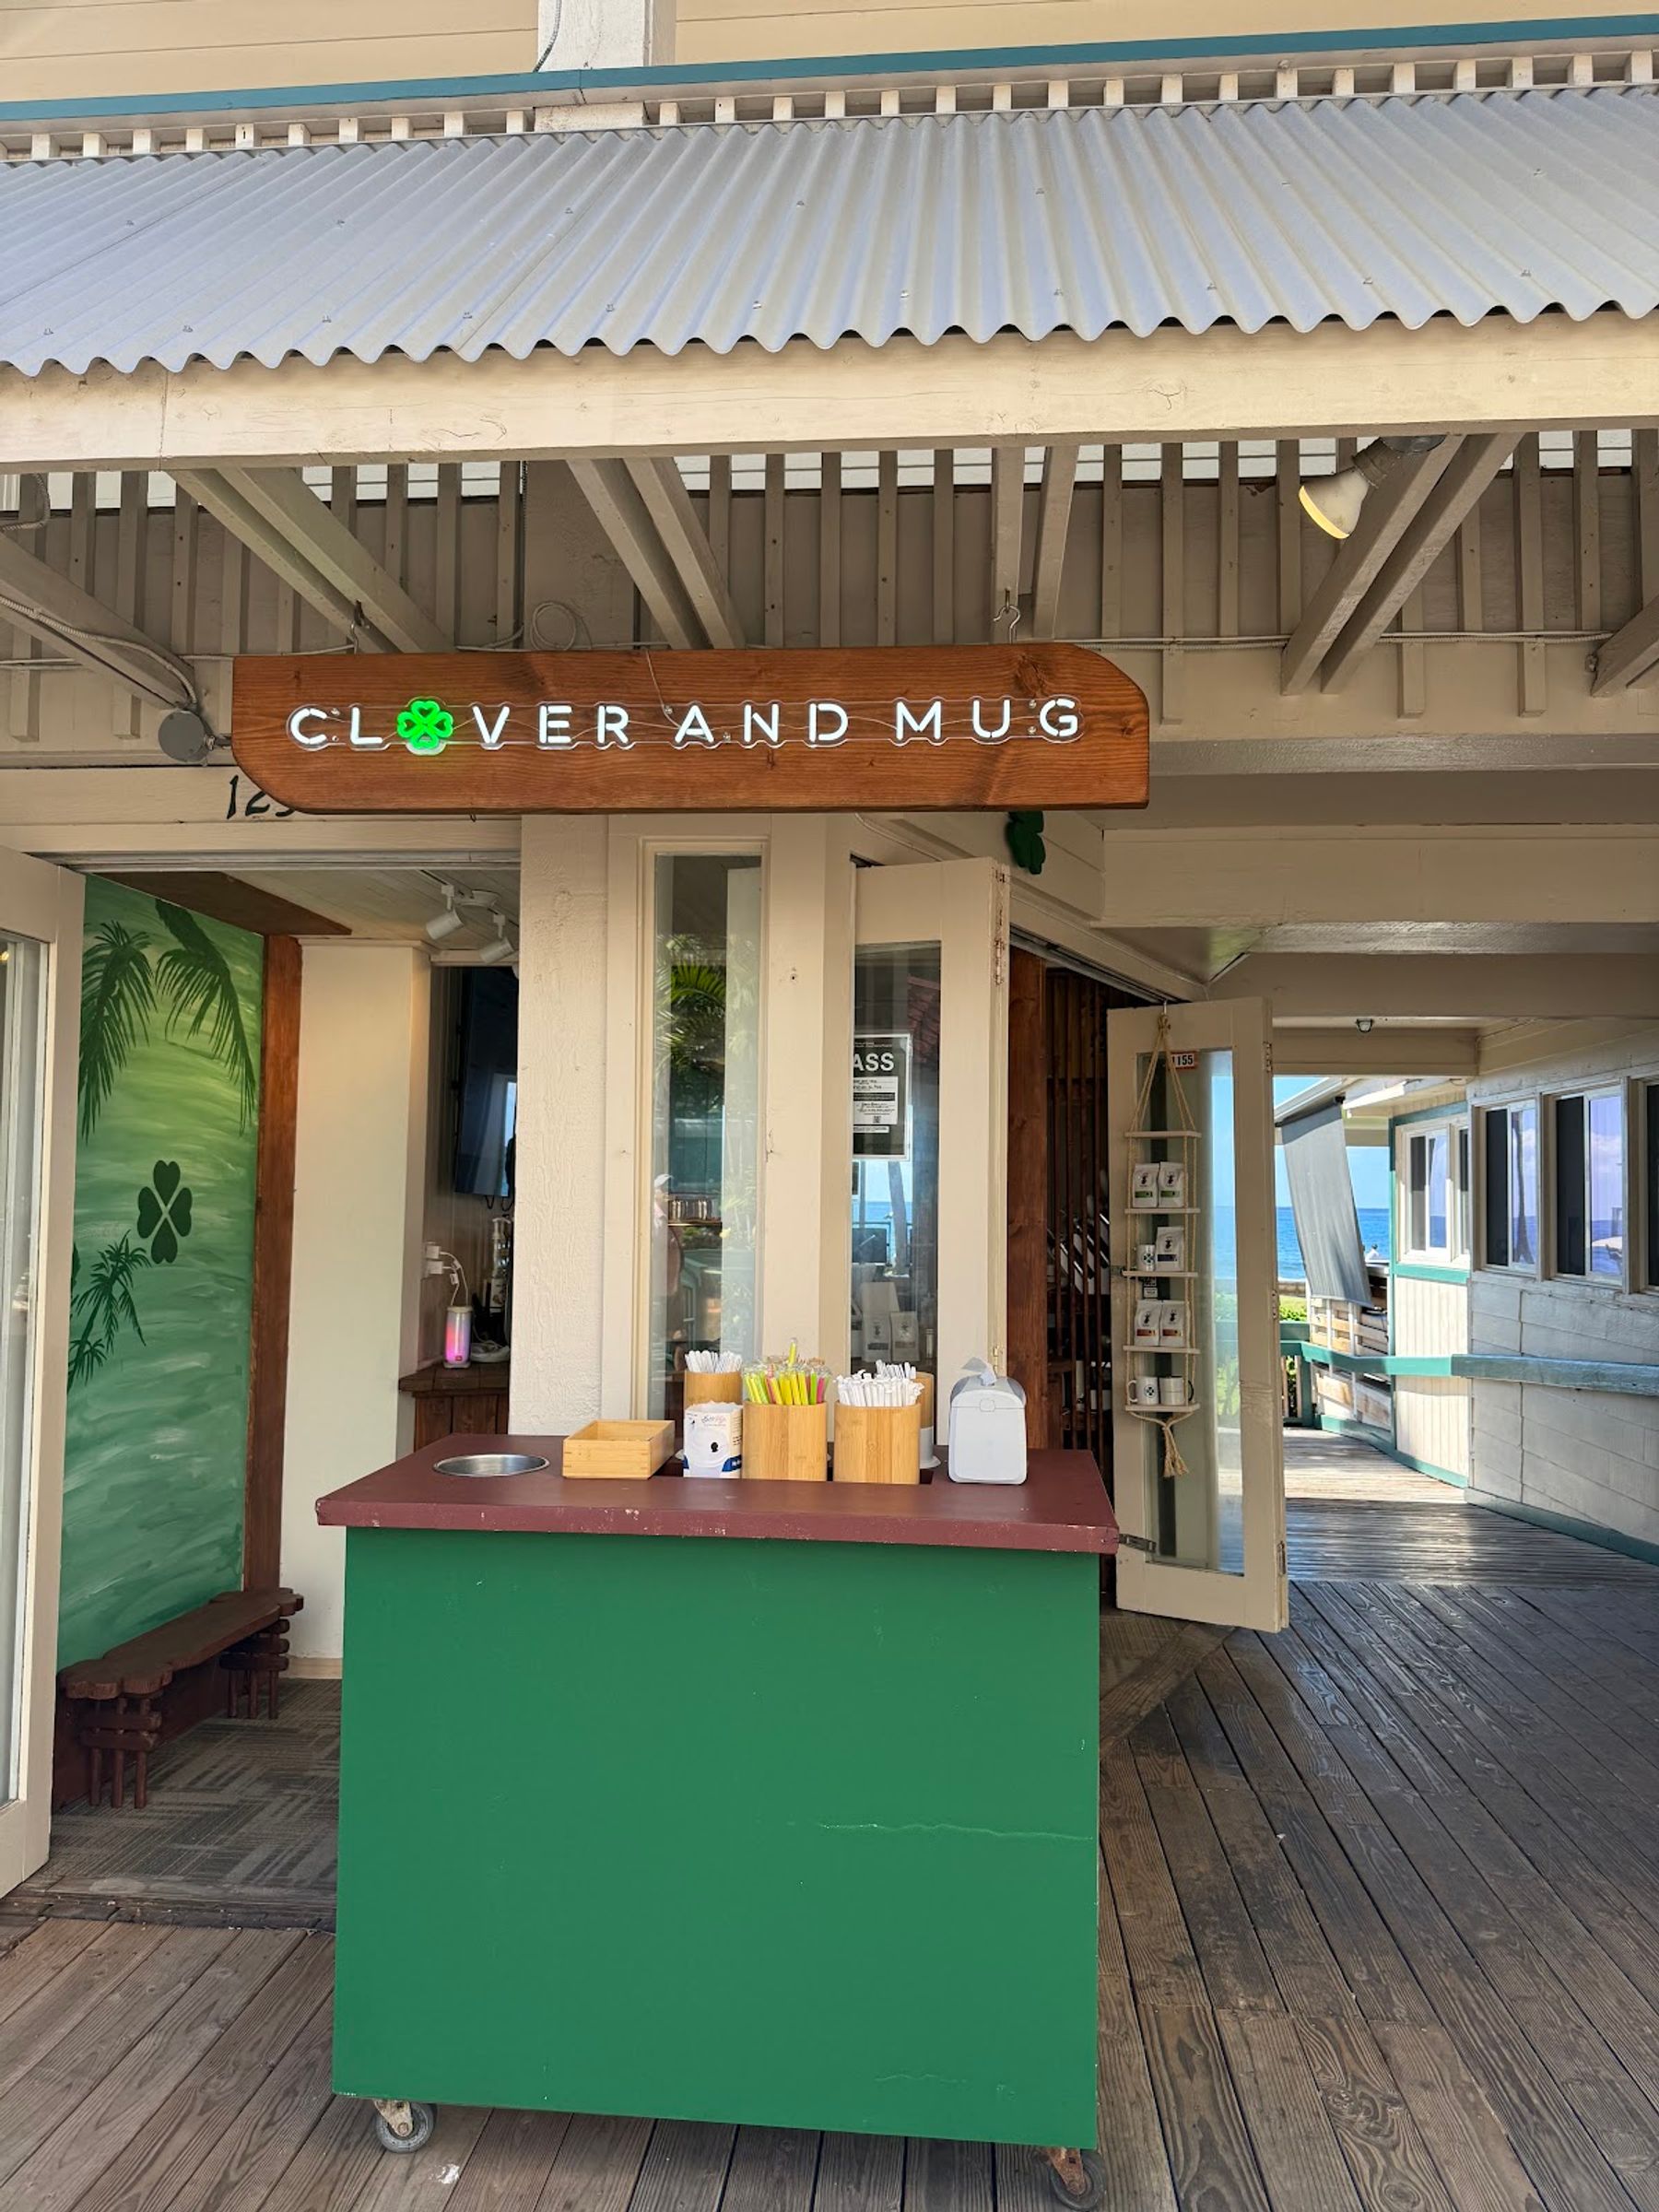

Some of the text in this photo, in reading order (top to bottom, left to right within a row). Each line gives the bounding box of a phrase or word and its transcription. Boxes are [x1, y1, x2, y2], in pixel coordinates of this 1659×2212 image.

[674, 702, 849, 744] AND
[895, 698, 1079, 741] MUG
[226, 774, 295, 819] 12
[853, 1053, 895, 1072] ASS
